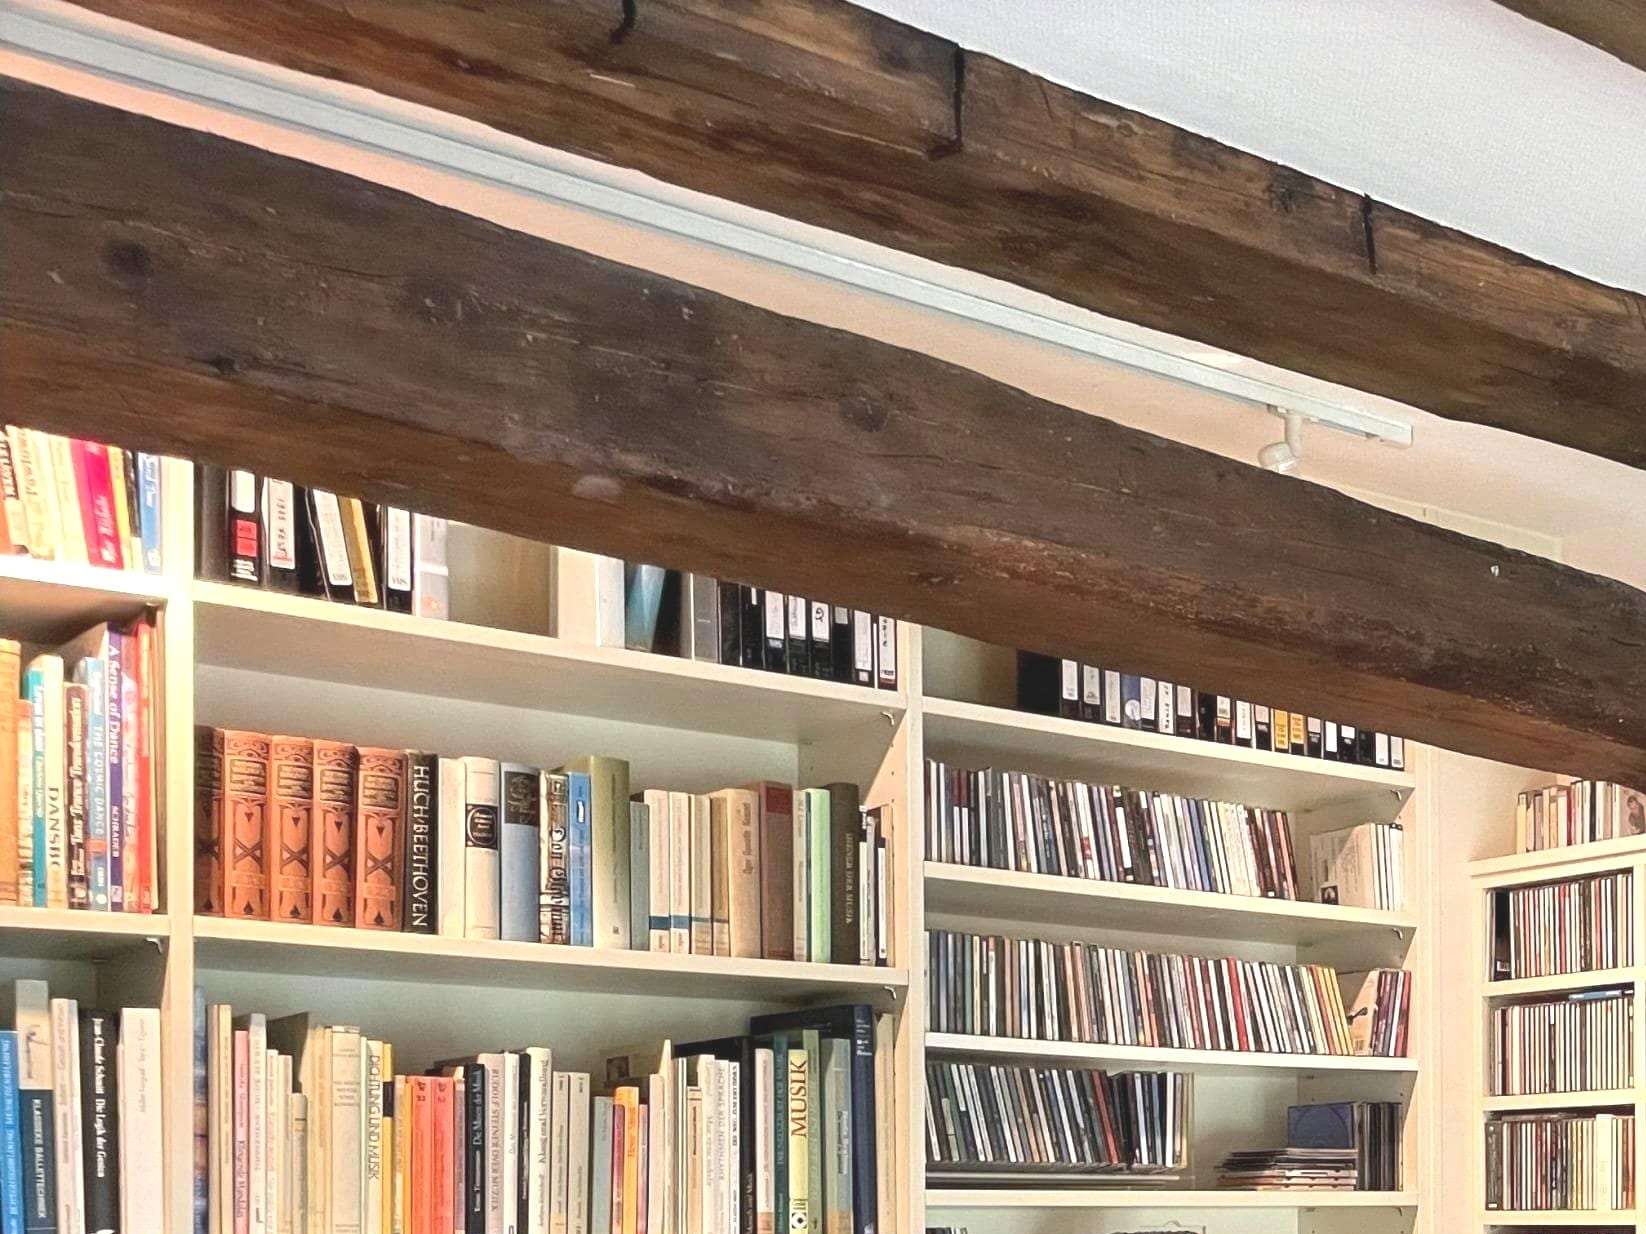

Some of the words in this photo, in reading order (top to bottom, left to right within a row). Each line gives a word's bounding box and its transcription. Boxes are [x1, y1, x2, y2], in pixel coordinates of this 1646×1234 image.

[109, 646, 120, 656] A
[109, 661, 121, 698] Sense
[109, 703, 122, 717] of
[109, 721, 122, 764] Dance
[368, 1055, 380, 1117] DICHTUNG
[790, 1060, 807, 1138] MUSIK
[368, 1121, 380, 1143] UND
[368, 1146, 380, 1181] MUSIK
